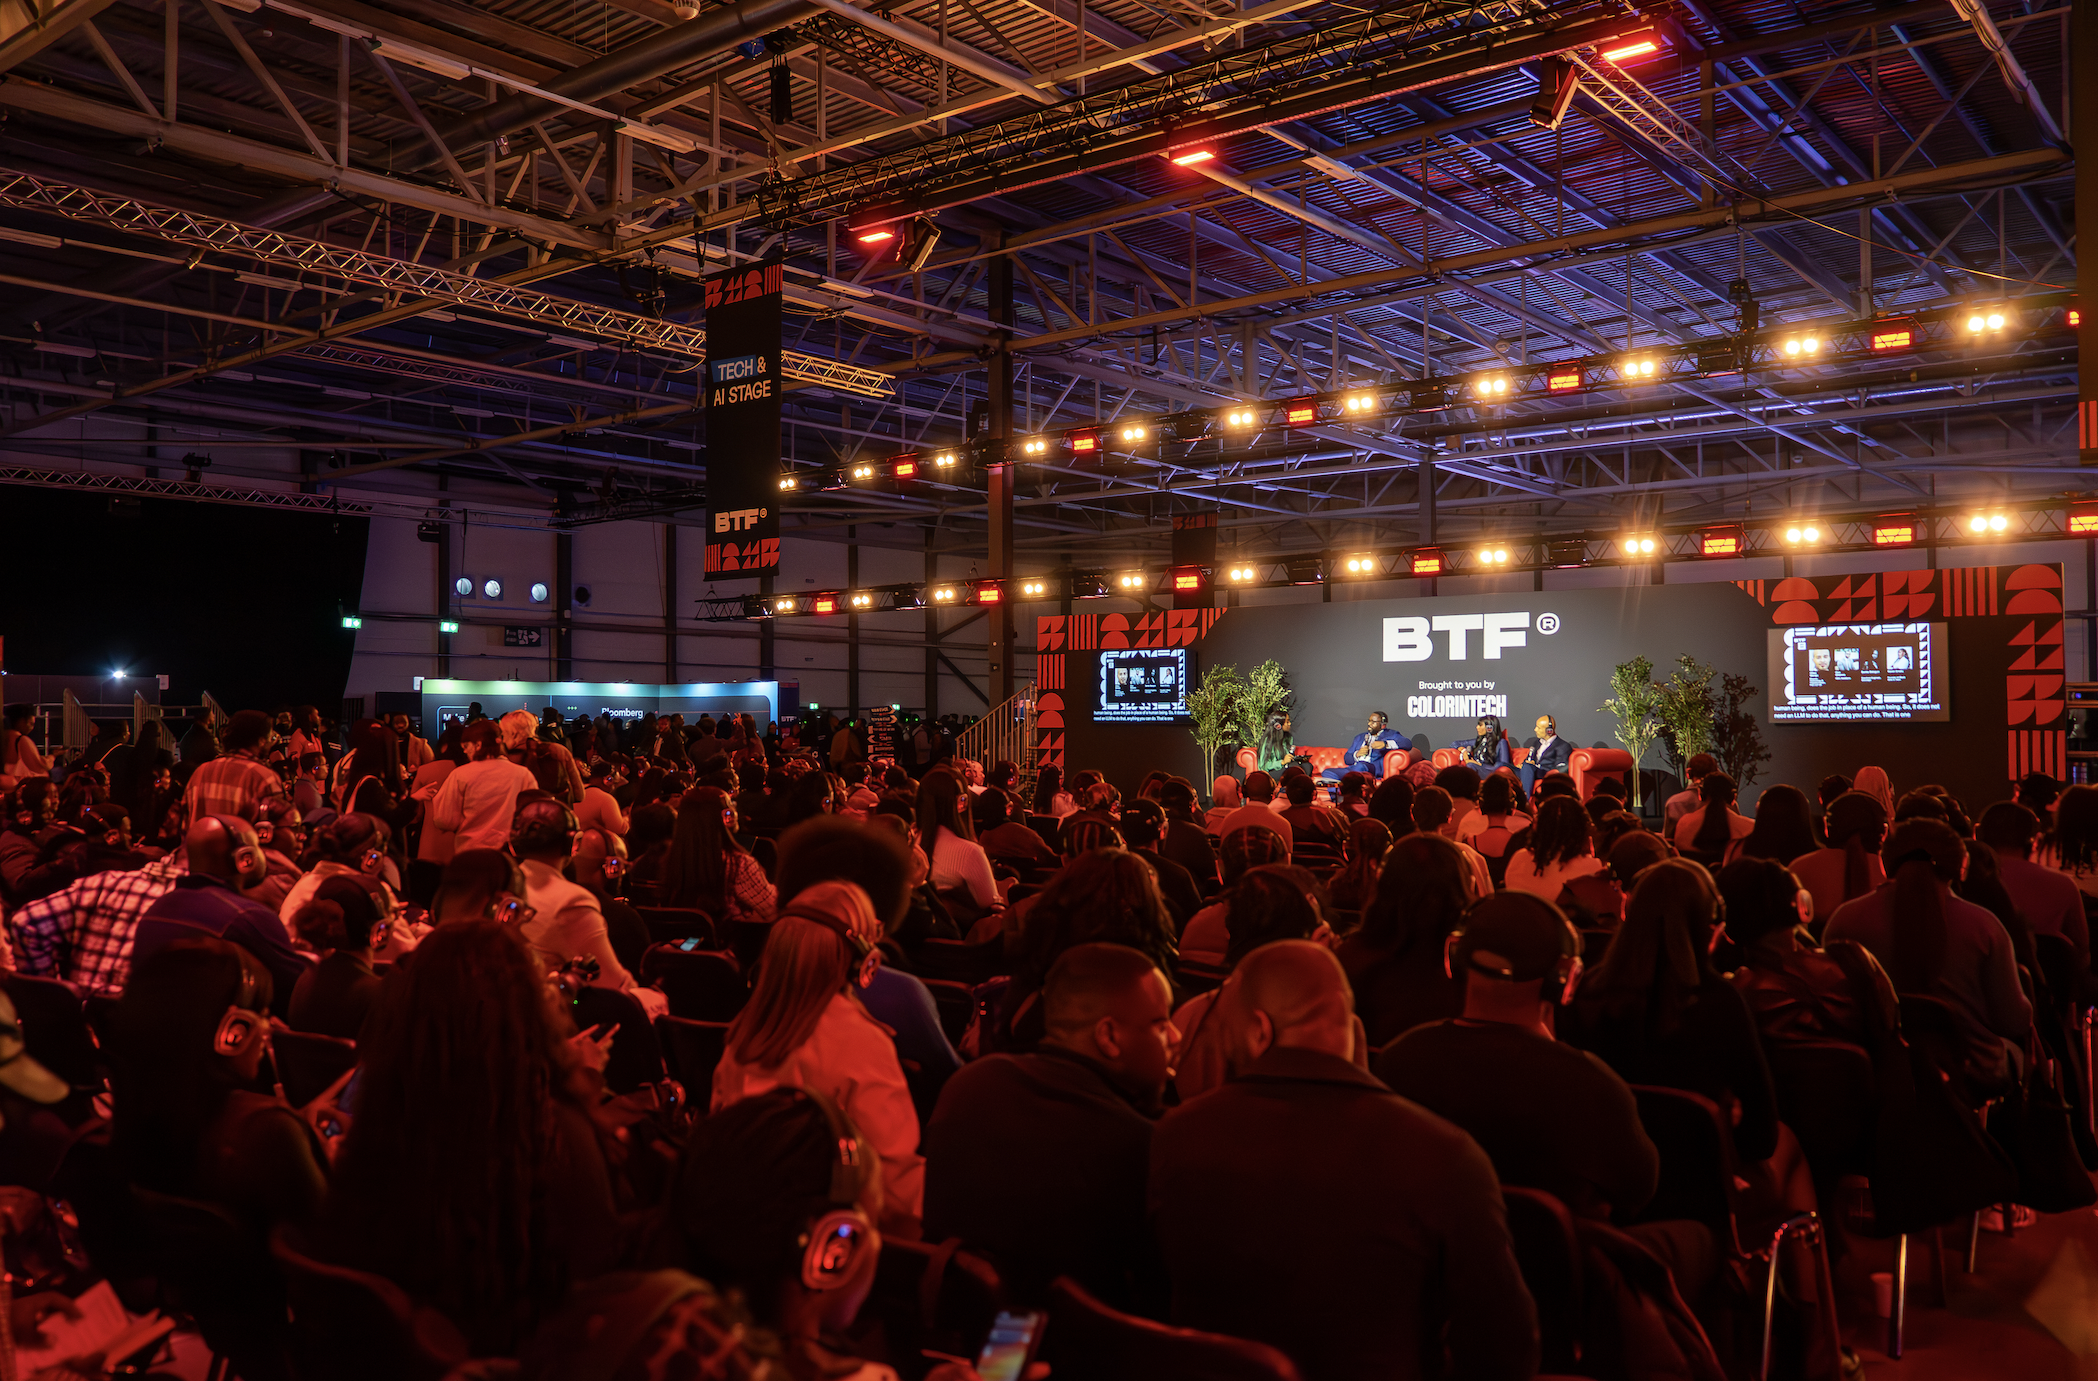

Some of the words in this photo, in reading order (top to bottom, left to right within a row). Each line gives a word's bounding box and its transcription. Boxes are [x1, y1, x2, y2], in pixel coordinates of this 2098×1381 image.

[718, 359, 753, 381] TECH
[757, 356, 767, 374] &
[714, 389, 725, 407] AI
[728, 380, 771, 403] STAGE
[1418, 681, 1453, 691] Brought
[1465, 682, 1482, 690] you
[1483, 680, 1495, 690] by
[443, 713, 465, 722] Me
[1407, 694, 1507, 718] COLORINTECH
